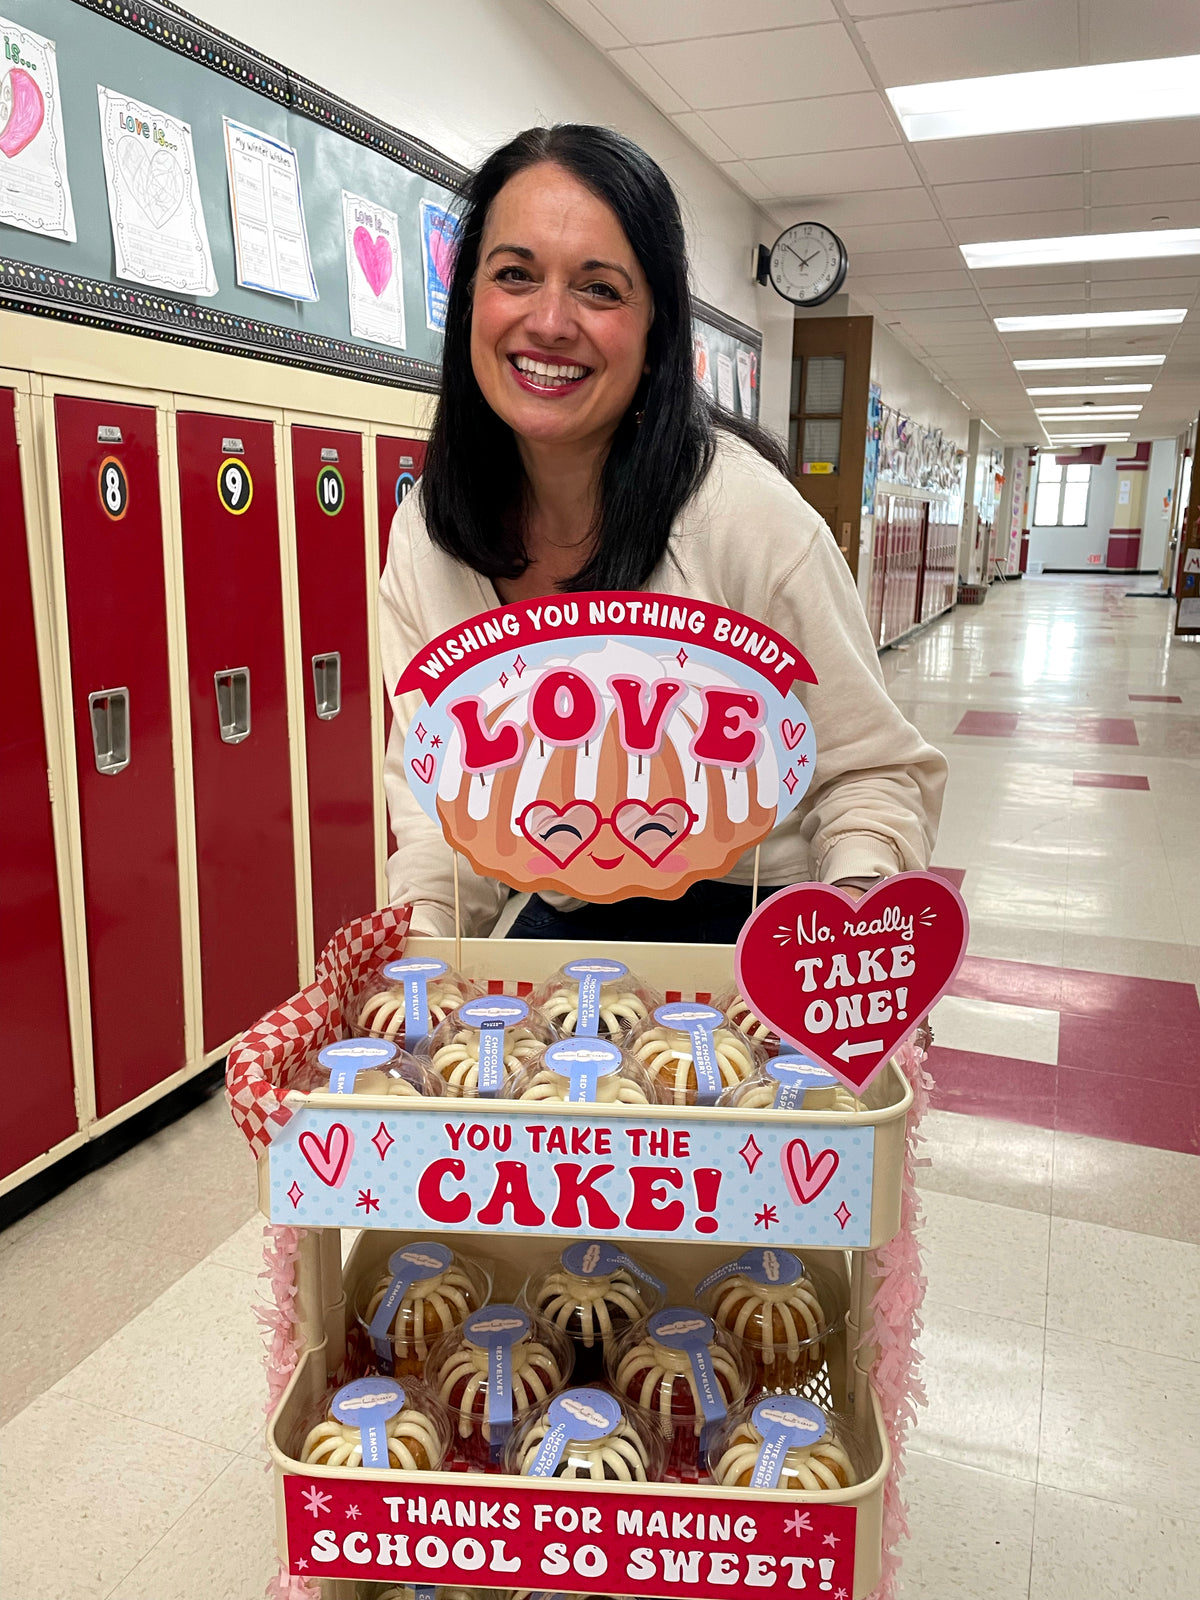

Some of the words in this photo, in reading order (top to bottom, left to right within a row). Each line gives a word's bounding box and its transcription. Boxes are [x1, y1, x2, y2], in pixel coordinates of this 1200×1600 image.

[119, 111, 151, 139] Love
[235, 137, 246, 151] My
[788, 231, 798, 239] 11
[803, 226, 813, 236] 12
[820, 231, 825, 239] 1
[828, 242, 835, 251] 2
[773, 258, 780, 268] 9
[830, 257, 837, 267] 3
[798, 289, 805, 299] 6
[105, 467, 122, 512] 8
[225, 467, 243, 506] 9
[323, 477, 339, 505] 10
[418, 613, 521, 680] WISHING
[526, 602, 579, 631] YOU
[589, 600, 706, 634] NOTHING
[712, 617, 796, 674] BUNDT
[446, 666, 763, 772] LOVE
[796, 910, 836, 946] No,
[842, 905, 914, 941] really
[794, 944, 916, 993] TAKE
[411, 981, 419, 993] RED
[412, 994, 420, 1021] VELVET
[581, 1009, 589, 1028] CHIP
[804, 986, 909, 1034] ONE!
[484, 1035, 492, 1055] CHIP
[483, 1056, 491, 1087] COOKIE
[490, 1036, 499, 1085] CHOCOLATE
[701, 1044, 716, 1091] CHOCOLATE
[579, 1074, 588, 1089] RED
[443, 1122, 512, 1152] YOU
[525, 1125, 613, 1155] TAKE
[624, 1127, 691, 1158] THE
[417, 1157, 723, 1235] CAKE!
[386, 1280, 403, 1308] LEMON
[495, 1345, 503, 1361] RED
[495, 1362, 504, 1396] VELVET
[695, 1352, 706, 1370] RED
[701, 1371, 715, 1404] VELVET
[368, 1427, 379, 1462] LEMON
[534, 1423, 566, 1472] CHOCOLATE
[770, 1434, 788, 1460] WHITE
[382, 1495, 521, 1530] THANKS
[533, 1504, 603, 1535] FOR
[616, 1509, 758, 1543] MAKING
[310, 1529, 522, 1573] SCHOOL
[540, 1542, 609, 1578] SO
[626, 1547, 836, 1591] SWEET!
